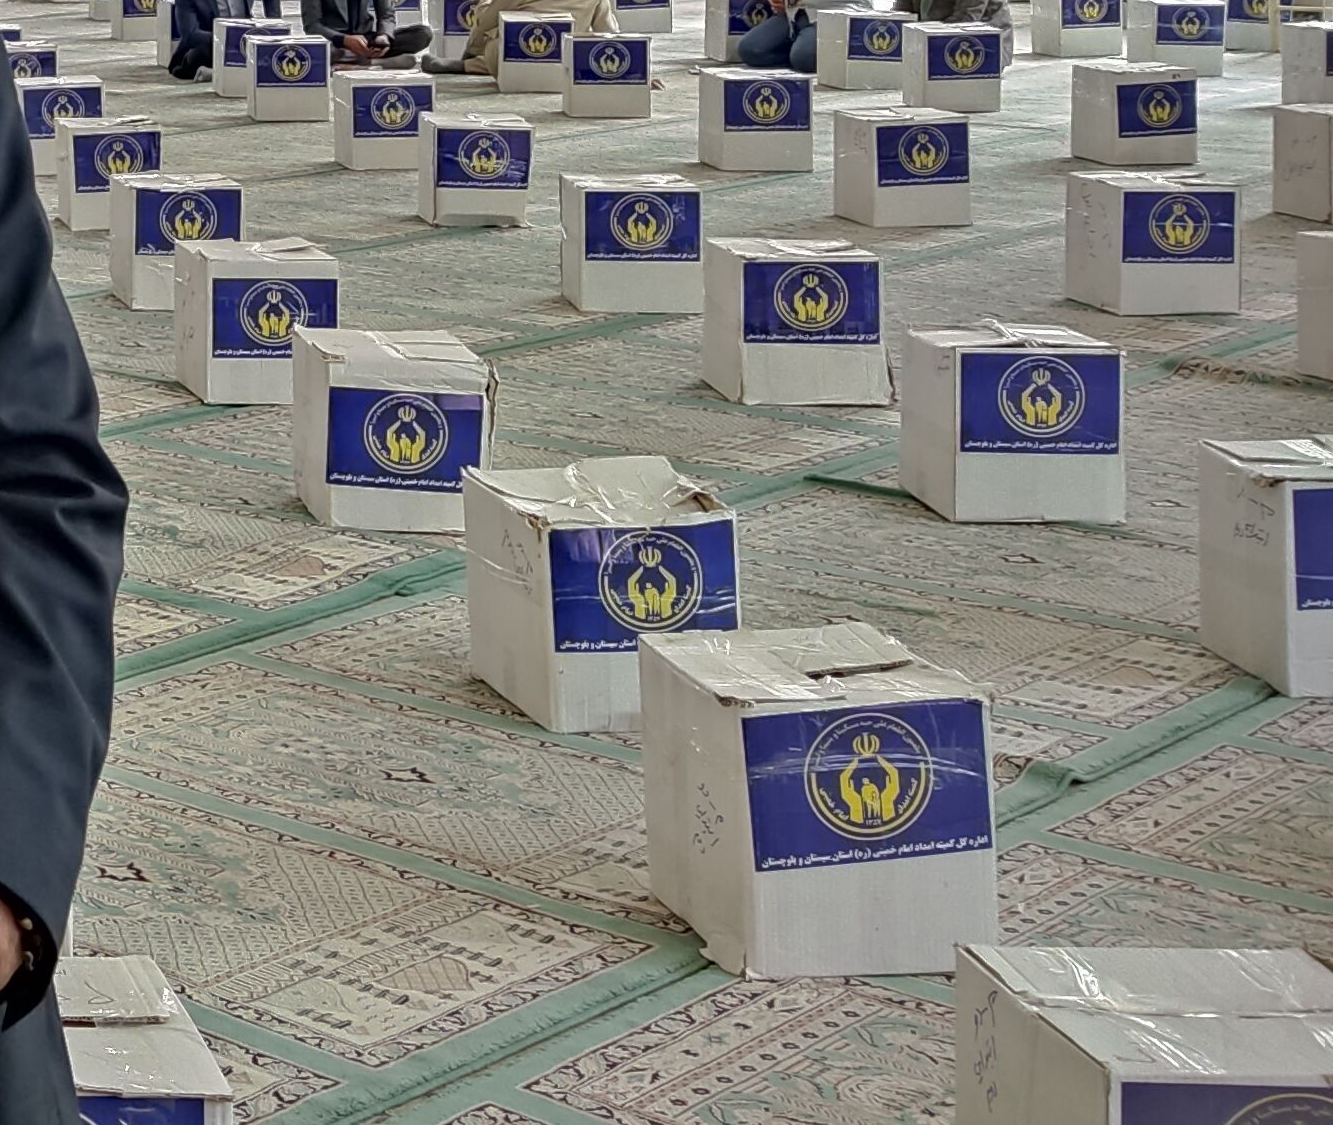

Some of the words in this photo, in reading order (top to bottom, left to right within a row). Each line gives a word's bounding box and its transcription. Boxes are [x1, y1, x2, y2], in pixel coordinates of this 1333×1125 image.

[915, 842, 934, 852] امداد
[935, 838, 954, 850] کمیته
[956, 837, 967, 848] کل
[970, 835, 988, 847] اداره
[831, 849, 853, 862] استان
[872, 846, 896, 858] خمینی
[898, 844, 914, 855] امام
[761, 854, 797, 869] بلوچستان
[804, 851, 831, 865] سیستان
